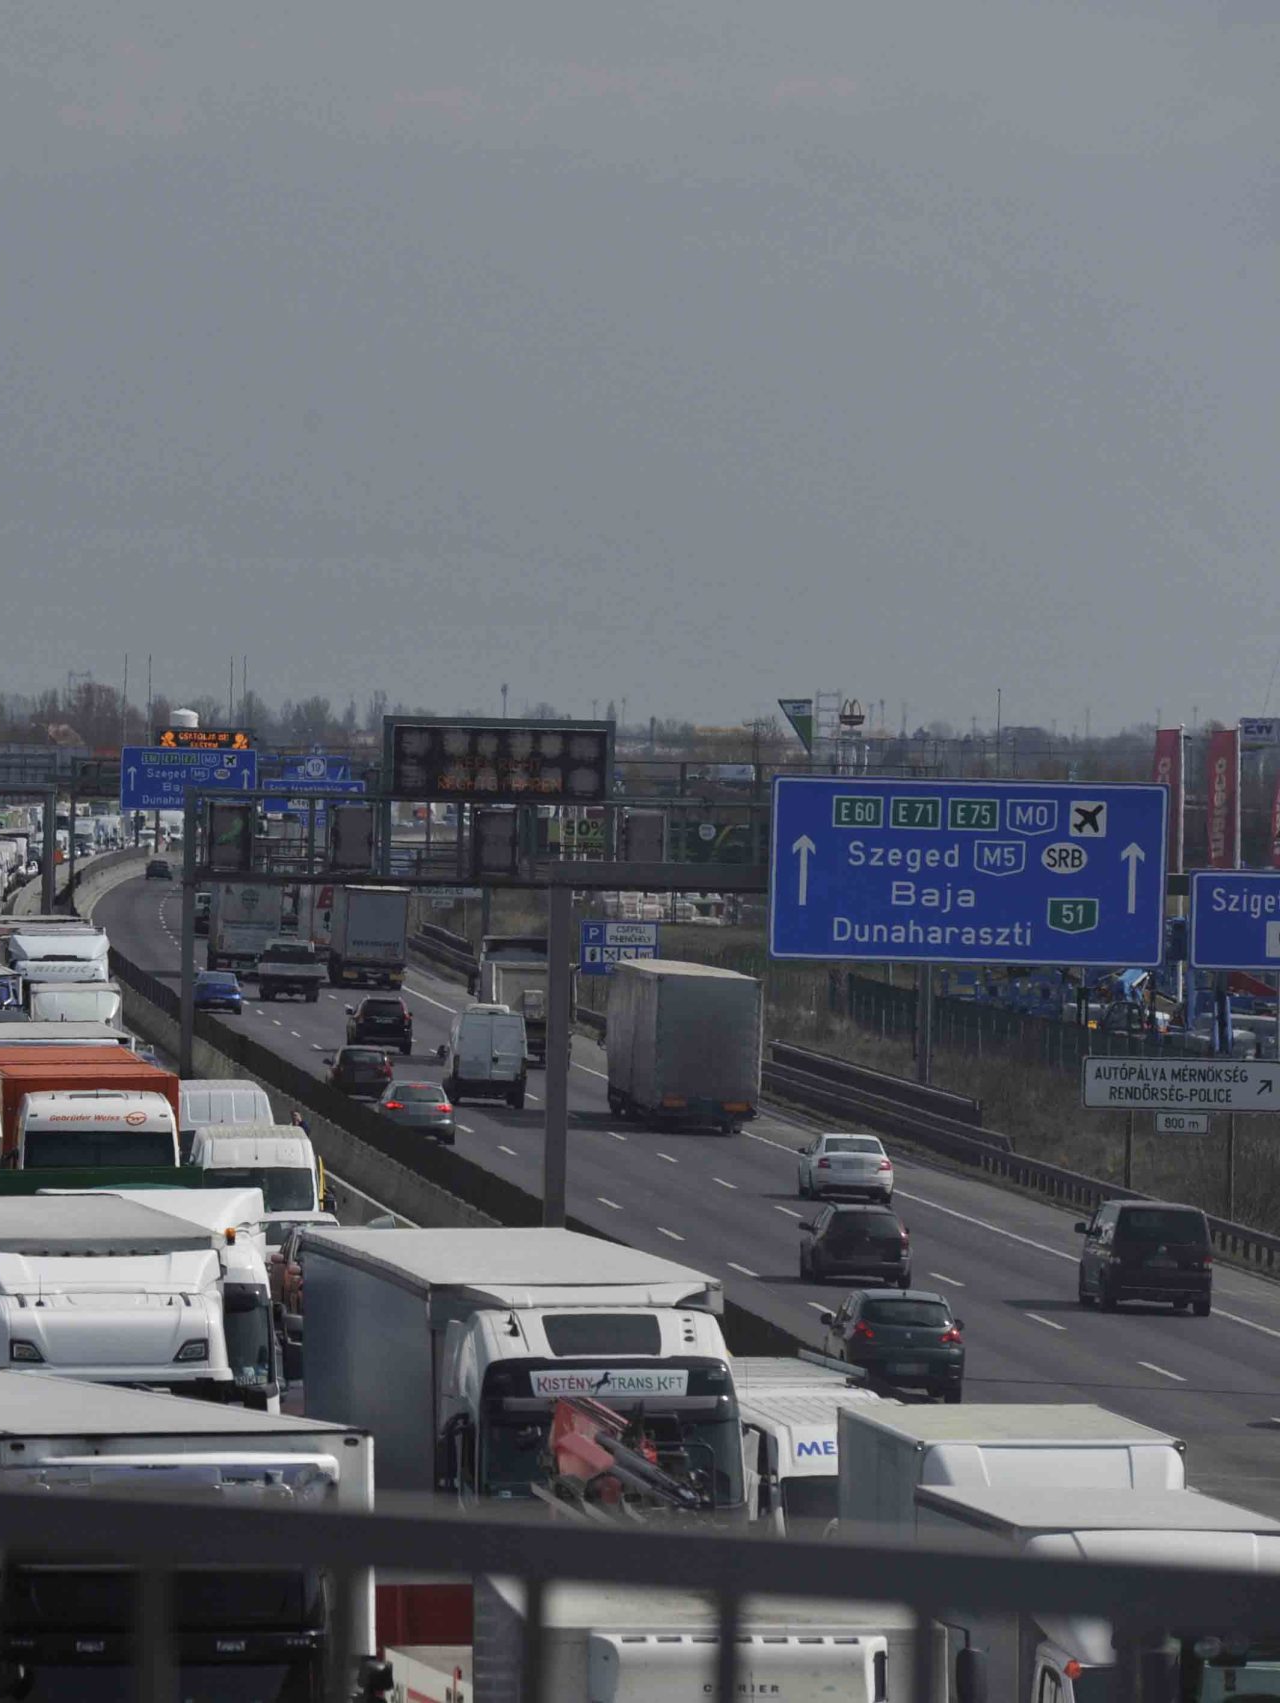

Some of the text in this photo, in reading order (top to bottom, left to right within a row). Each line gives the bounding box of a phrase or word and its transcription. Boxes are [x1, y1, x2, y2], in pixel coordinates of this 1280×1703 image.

[147, 768, 186, 780] Szeged
[1016, 806, 1048, 826] M0
[848, 841, 1083, 873] Szeged M5 SRB
[891, 881, 975, 913] Baja
[1061, 904, 1084, 924] 51
[588, 927, 600, 940] P
[833, 917, 1032, 946] Dunaharaszti
[1095, 1064, 1248, 1083] AUTÓPÁLYA MÉRNÖKSÉG
[94, 1114, 120, 1122] Weiss
[1164, 1118, 1199, 1129] 800 m
[537, 1375, 684, 1392] KISTÉNY TRANS KFT
[703, 1684, 780, 1693] CRIER
